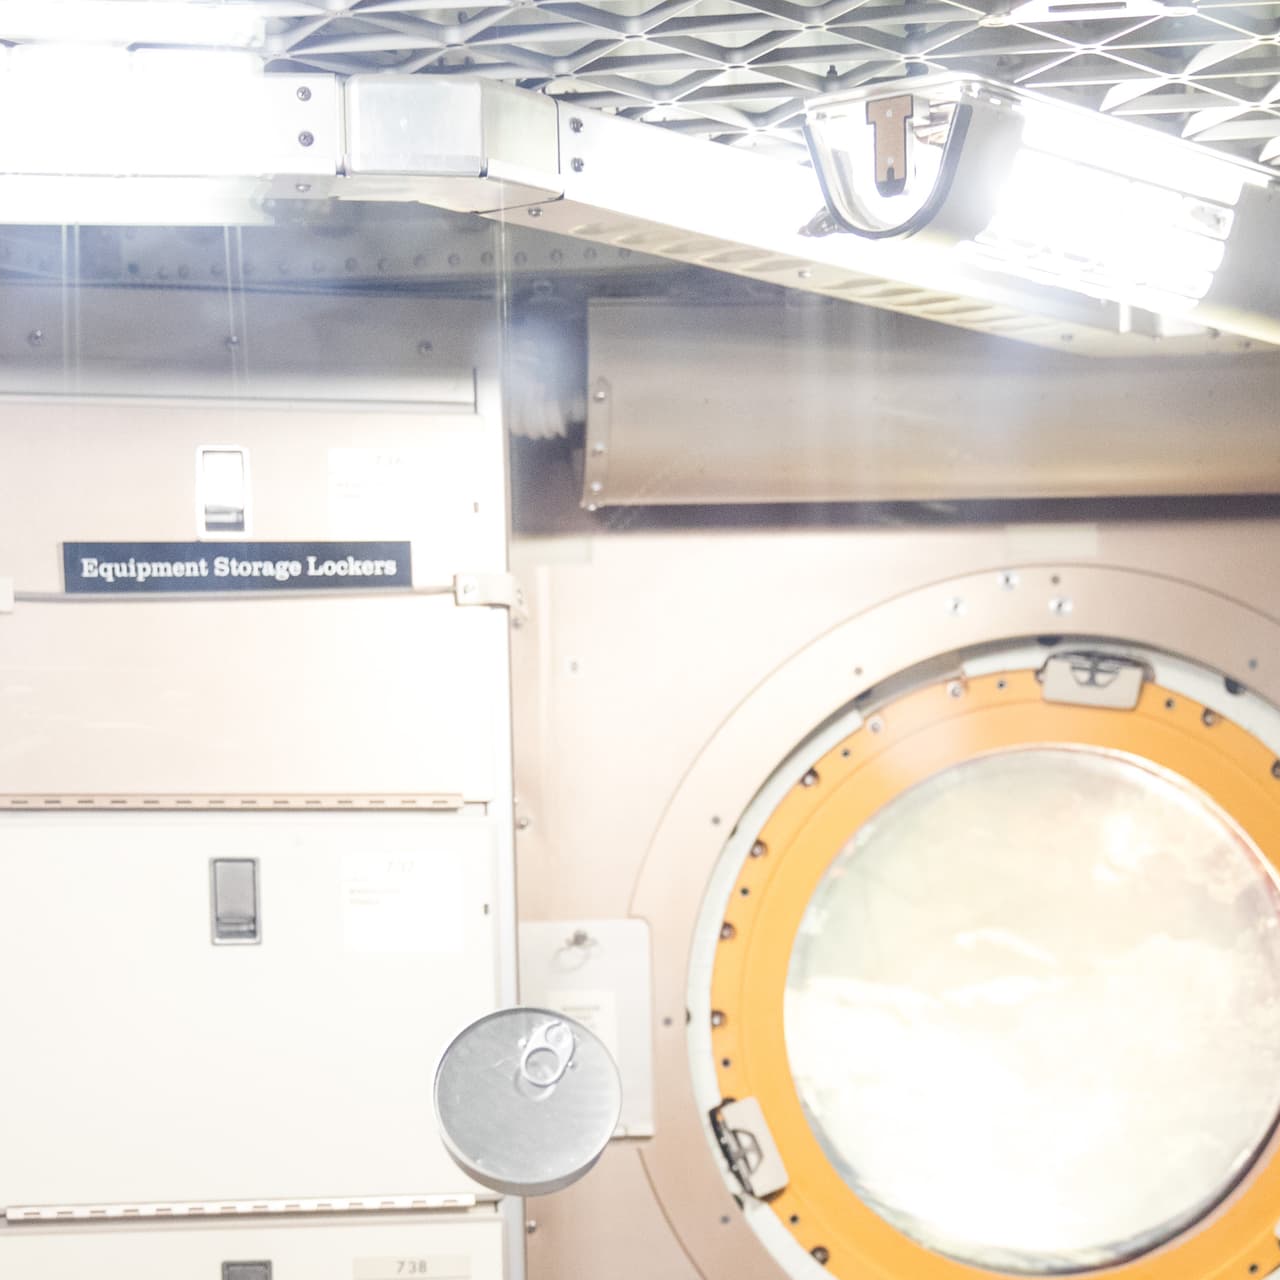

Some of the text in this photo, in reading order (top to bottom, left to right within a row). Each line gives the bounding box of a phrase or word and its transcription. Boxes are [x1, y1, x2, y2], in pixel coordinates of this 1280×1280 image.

[80, 555, 397, 582] Equipment Storage Lockers
[396, 1260, 428, 1274] 738
